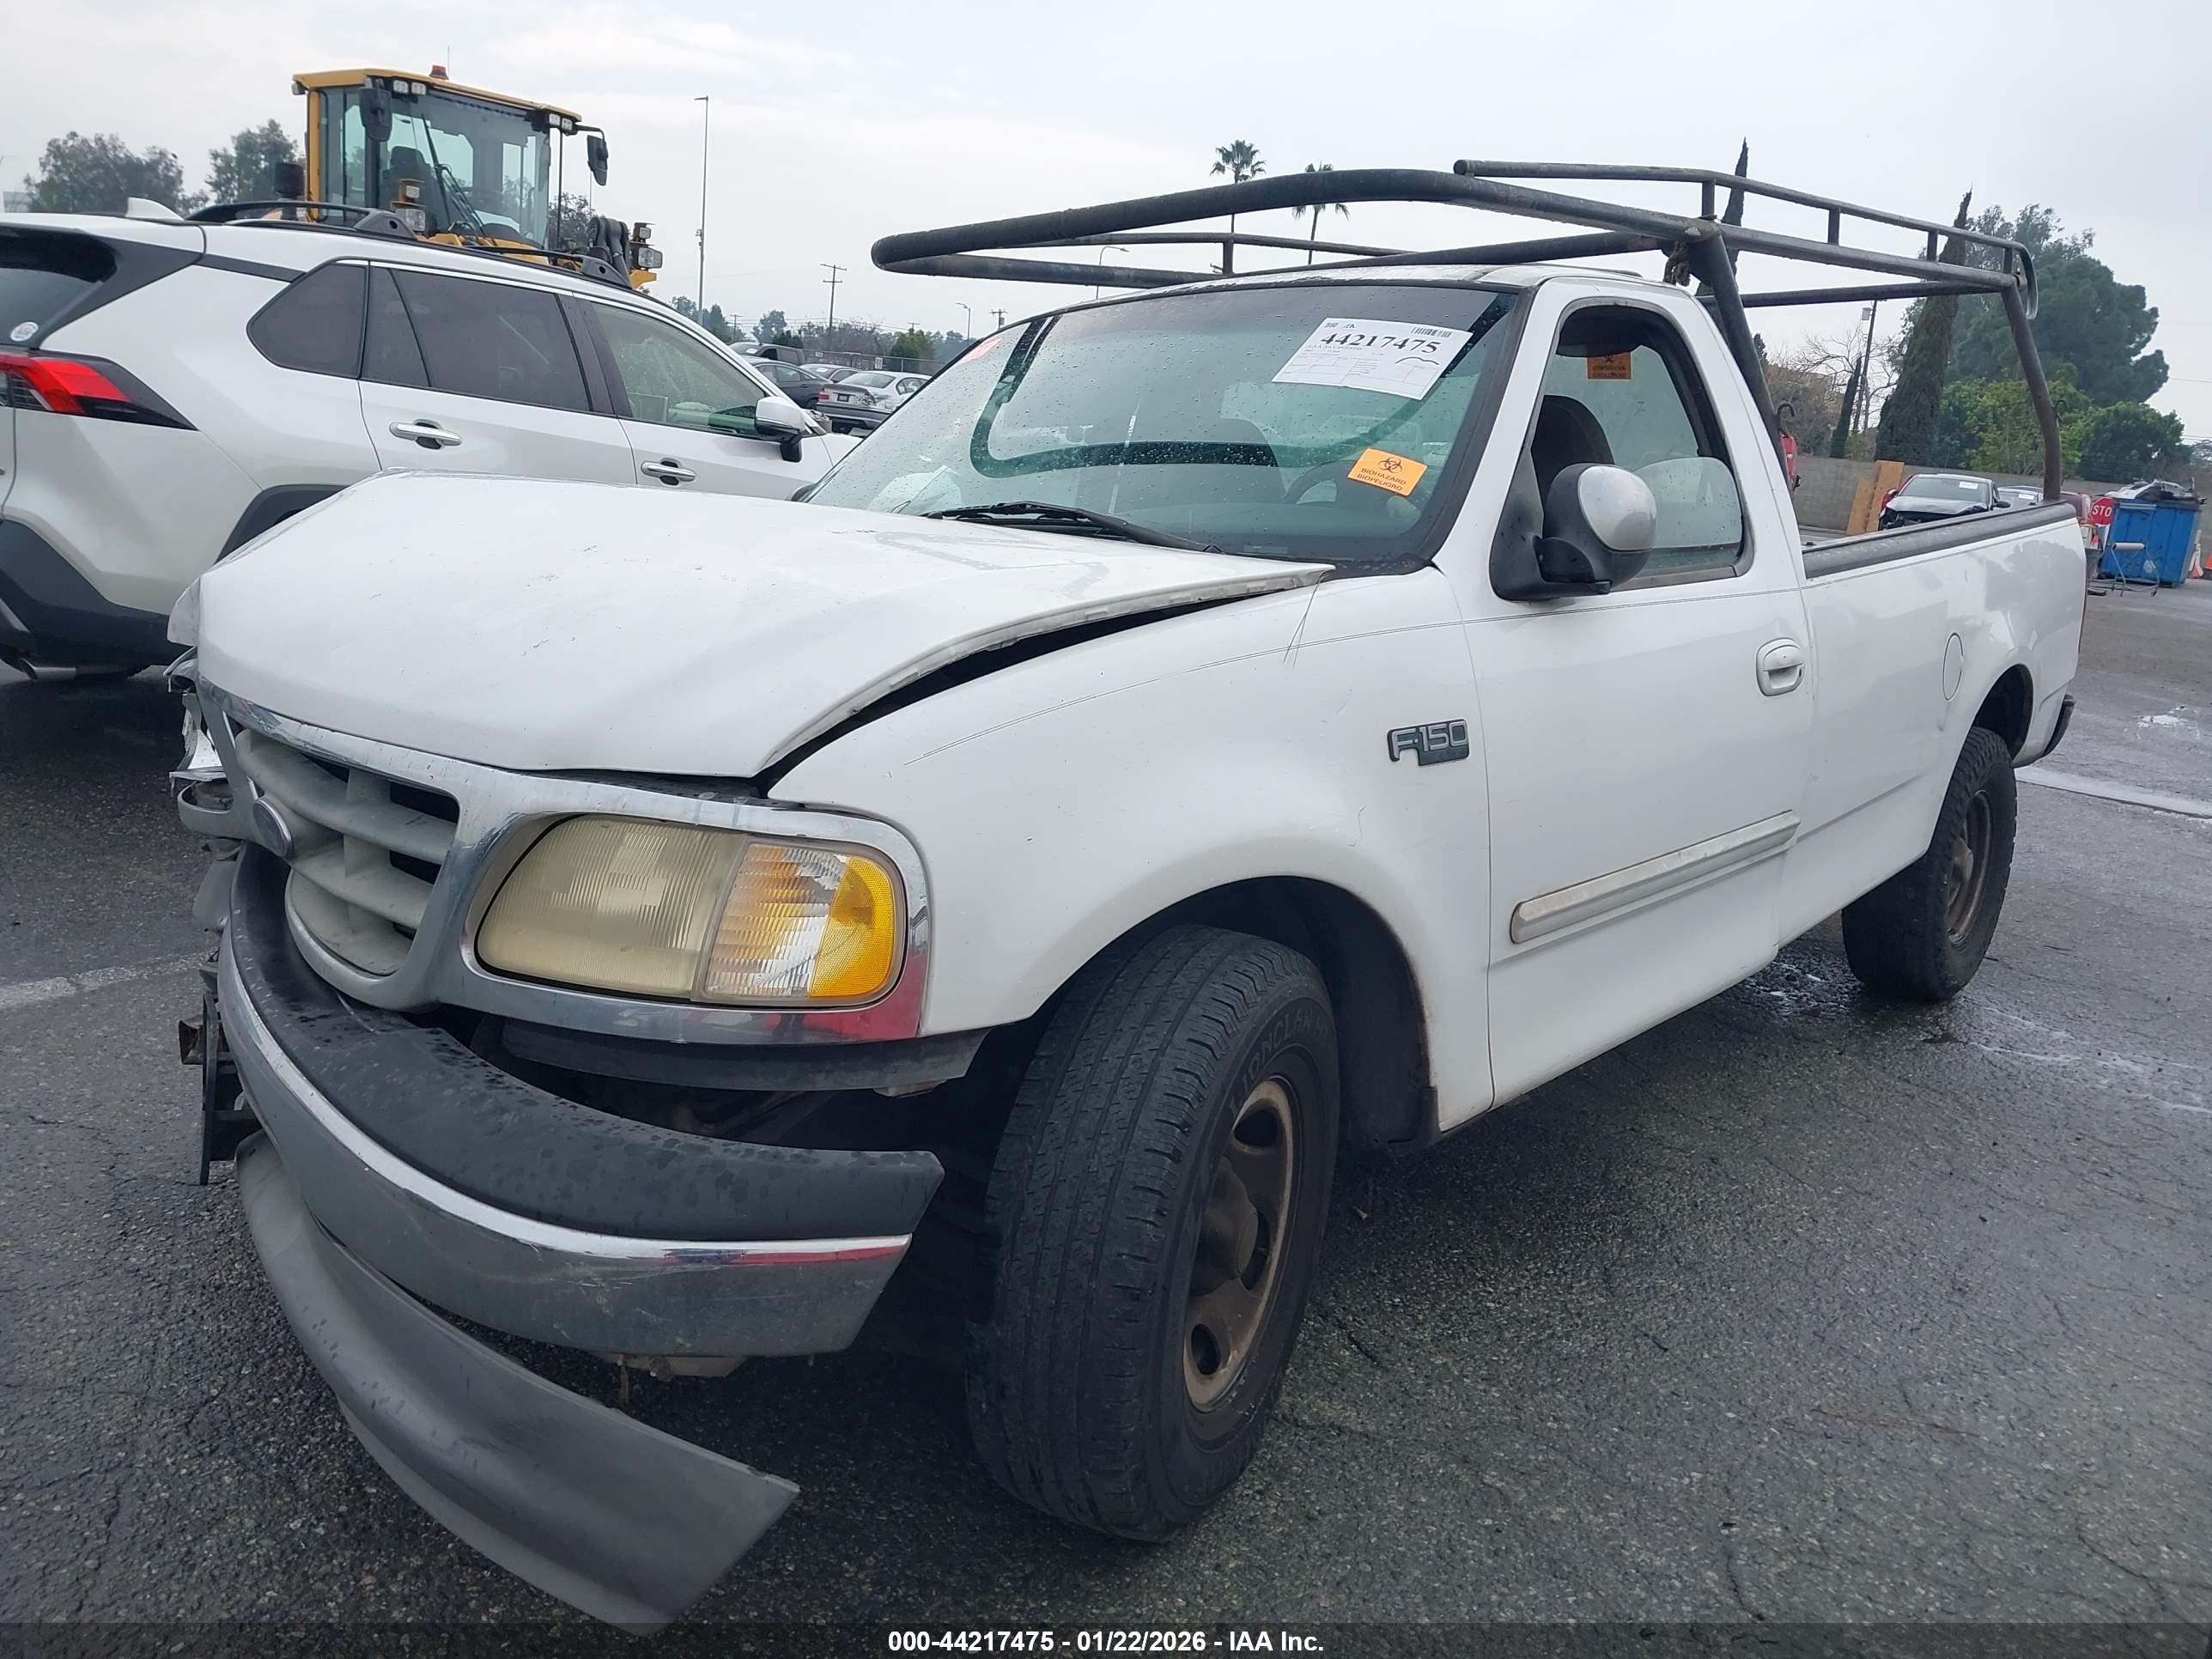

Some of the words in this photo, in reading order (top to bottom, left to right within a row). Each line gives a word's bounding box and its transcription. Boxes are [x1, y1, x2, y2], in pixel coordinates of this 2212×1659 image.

[1321, 332, 1443, 354] 44217475
[1357, 473, 1403, 492] BIOPELIGRO
[1360, 467, 1407, 485] BIOHAZARD
[2092, 504, 2112, 517] STO
